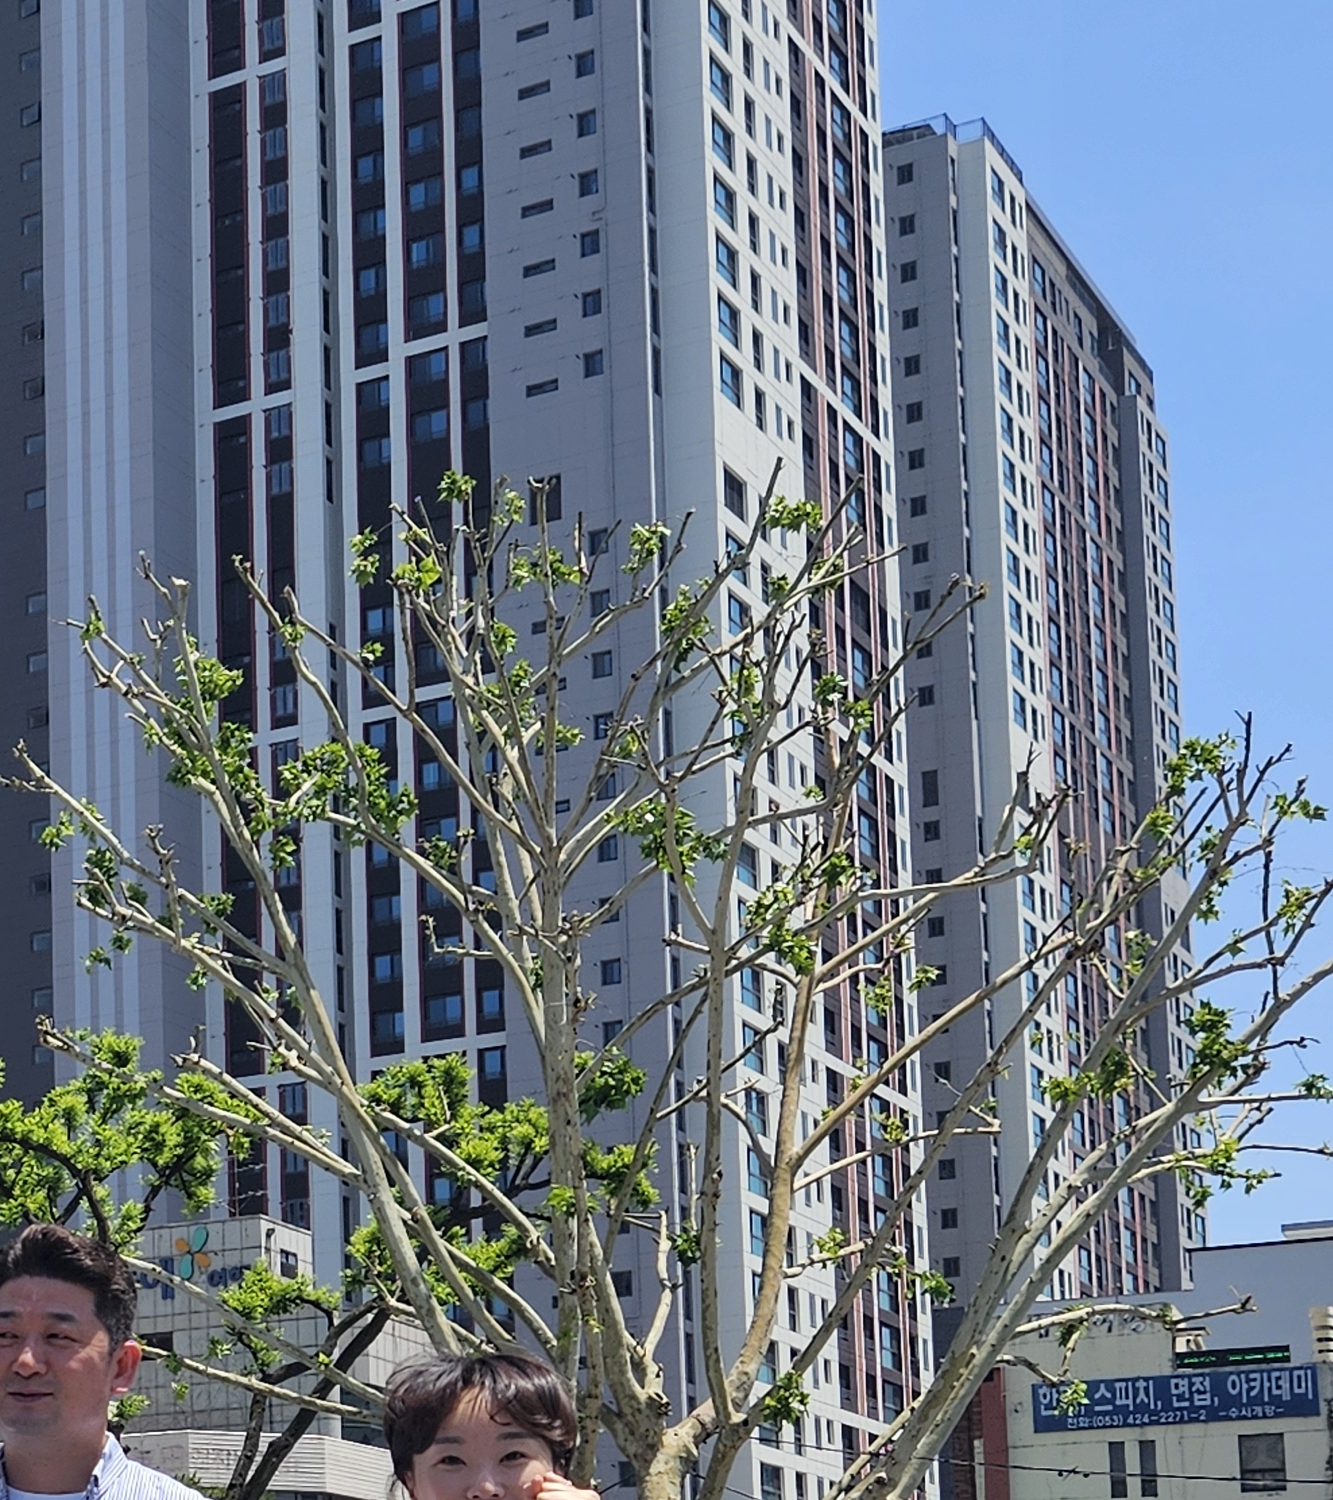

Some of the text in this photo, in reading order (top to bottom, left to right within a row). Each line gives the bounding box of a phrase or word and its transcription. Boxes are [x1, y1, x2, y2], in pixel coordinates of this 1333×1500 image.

[1094, 1380, 1162, 1411] 스피치,
[1170, 1376, 1219, 1407] 면접,
[1227, 1368, 1313, 1403] 아카데미
